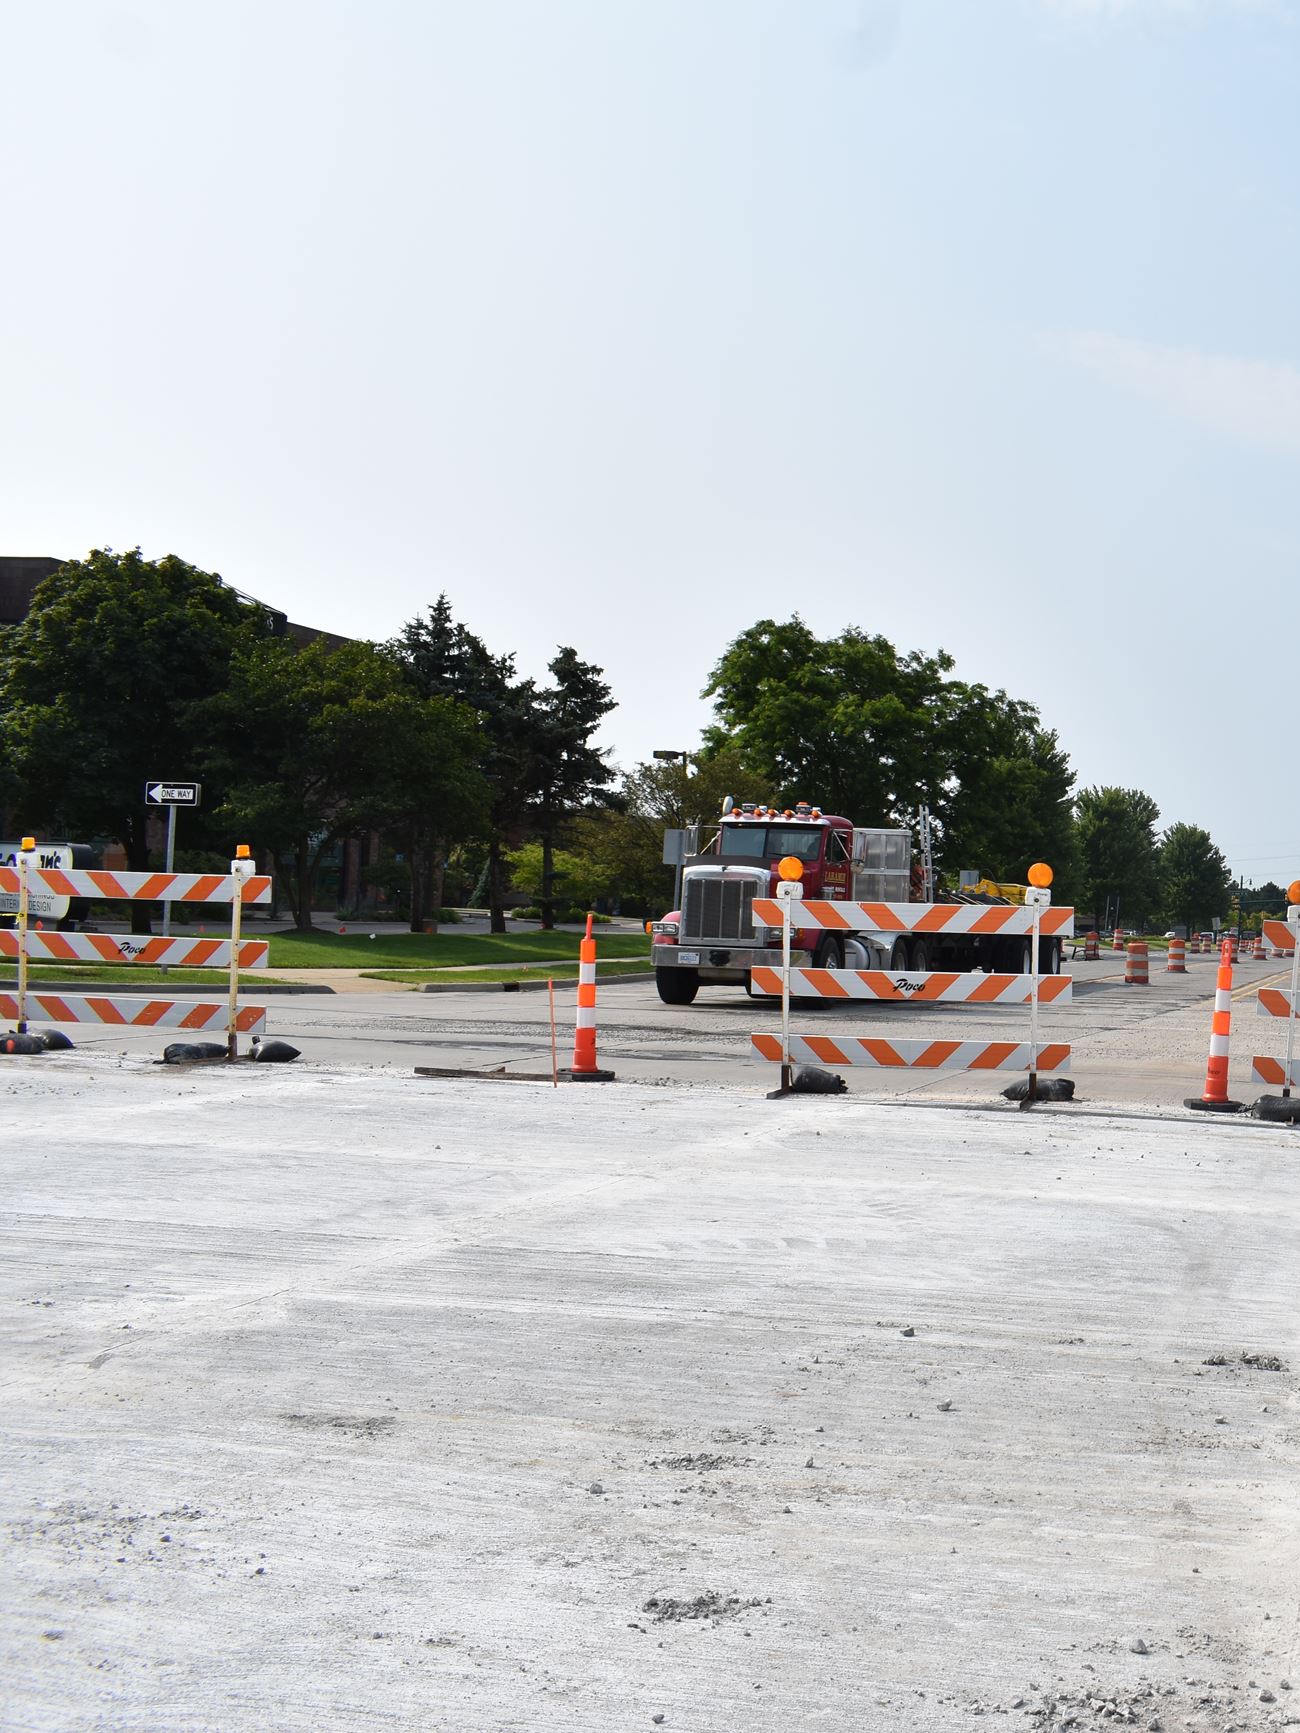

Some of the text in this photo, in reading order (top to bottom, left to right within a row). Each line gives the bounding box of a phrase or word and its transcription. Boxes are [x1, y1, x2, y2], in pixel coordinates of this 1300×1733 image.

[161, 789, 192, 798] ONE WAY
[118, 941, 146, 954] Poco
[892, 978, 926, 992] Poco
